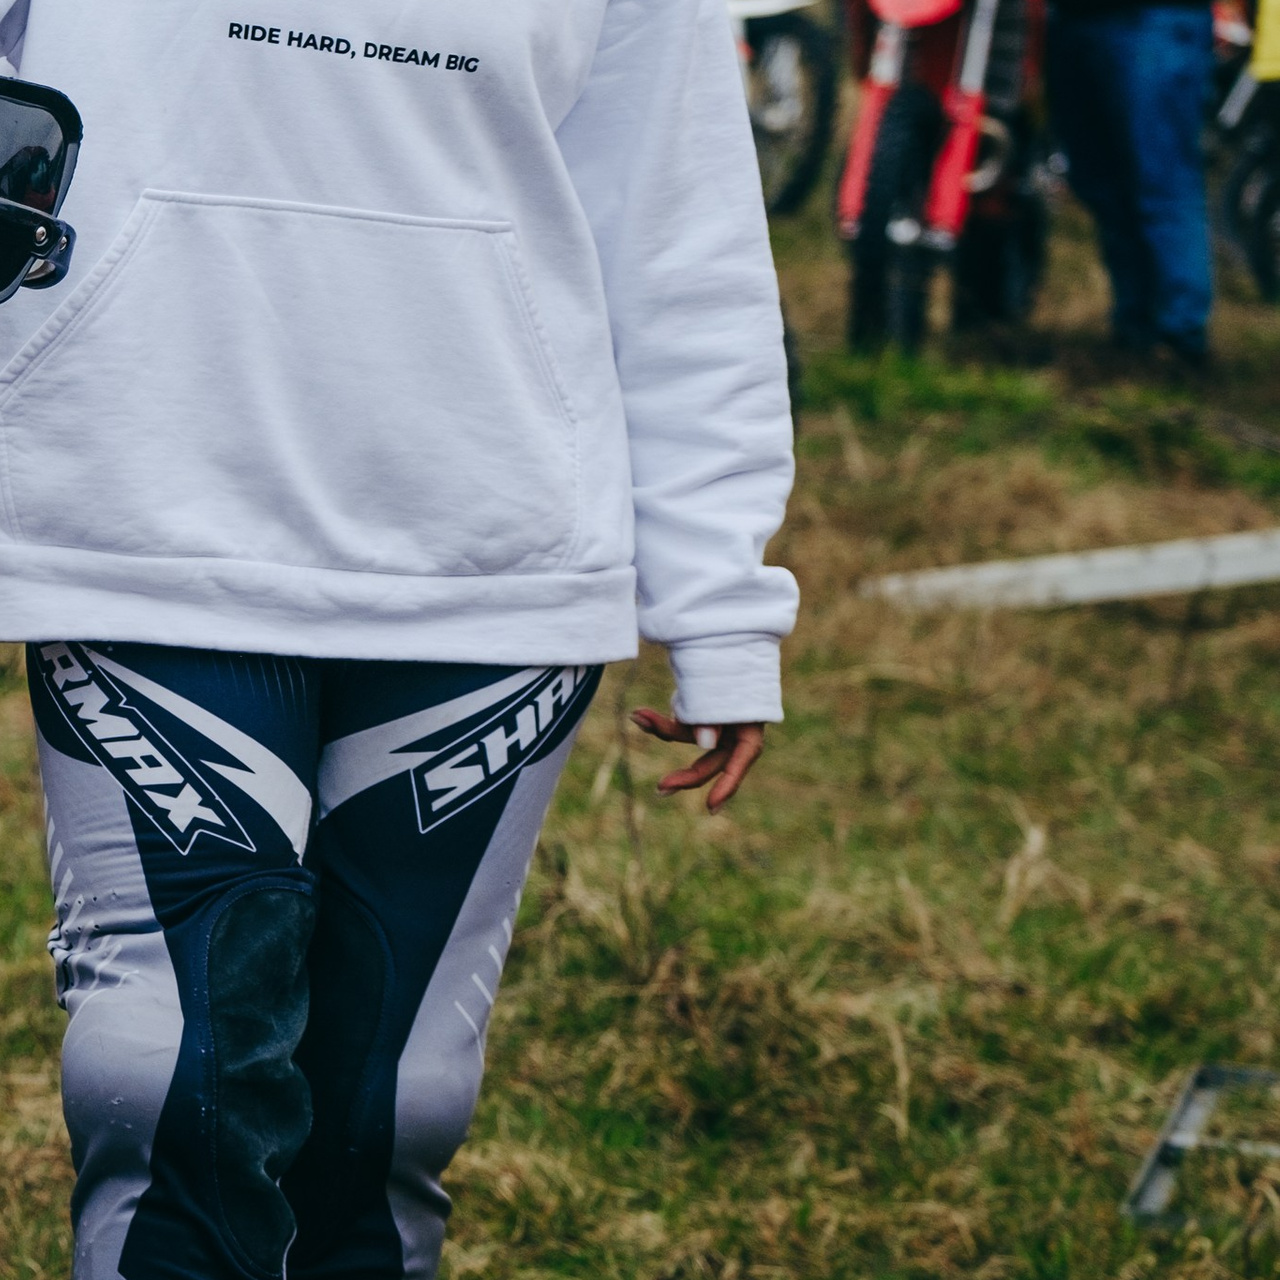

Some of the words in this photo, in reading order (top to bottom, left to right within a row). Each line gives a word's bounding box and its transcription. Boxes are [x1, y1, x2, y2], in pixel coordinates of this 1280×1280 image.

[228, 22, 281, 45] RIDE
[287, 30, 356, 59] HARD,
[364, 41, 441, 69] DREAM
[445, 54, 480, 74] BIG
[424, 665, 587, 812] SHA
